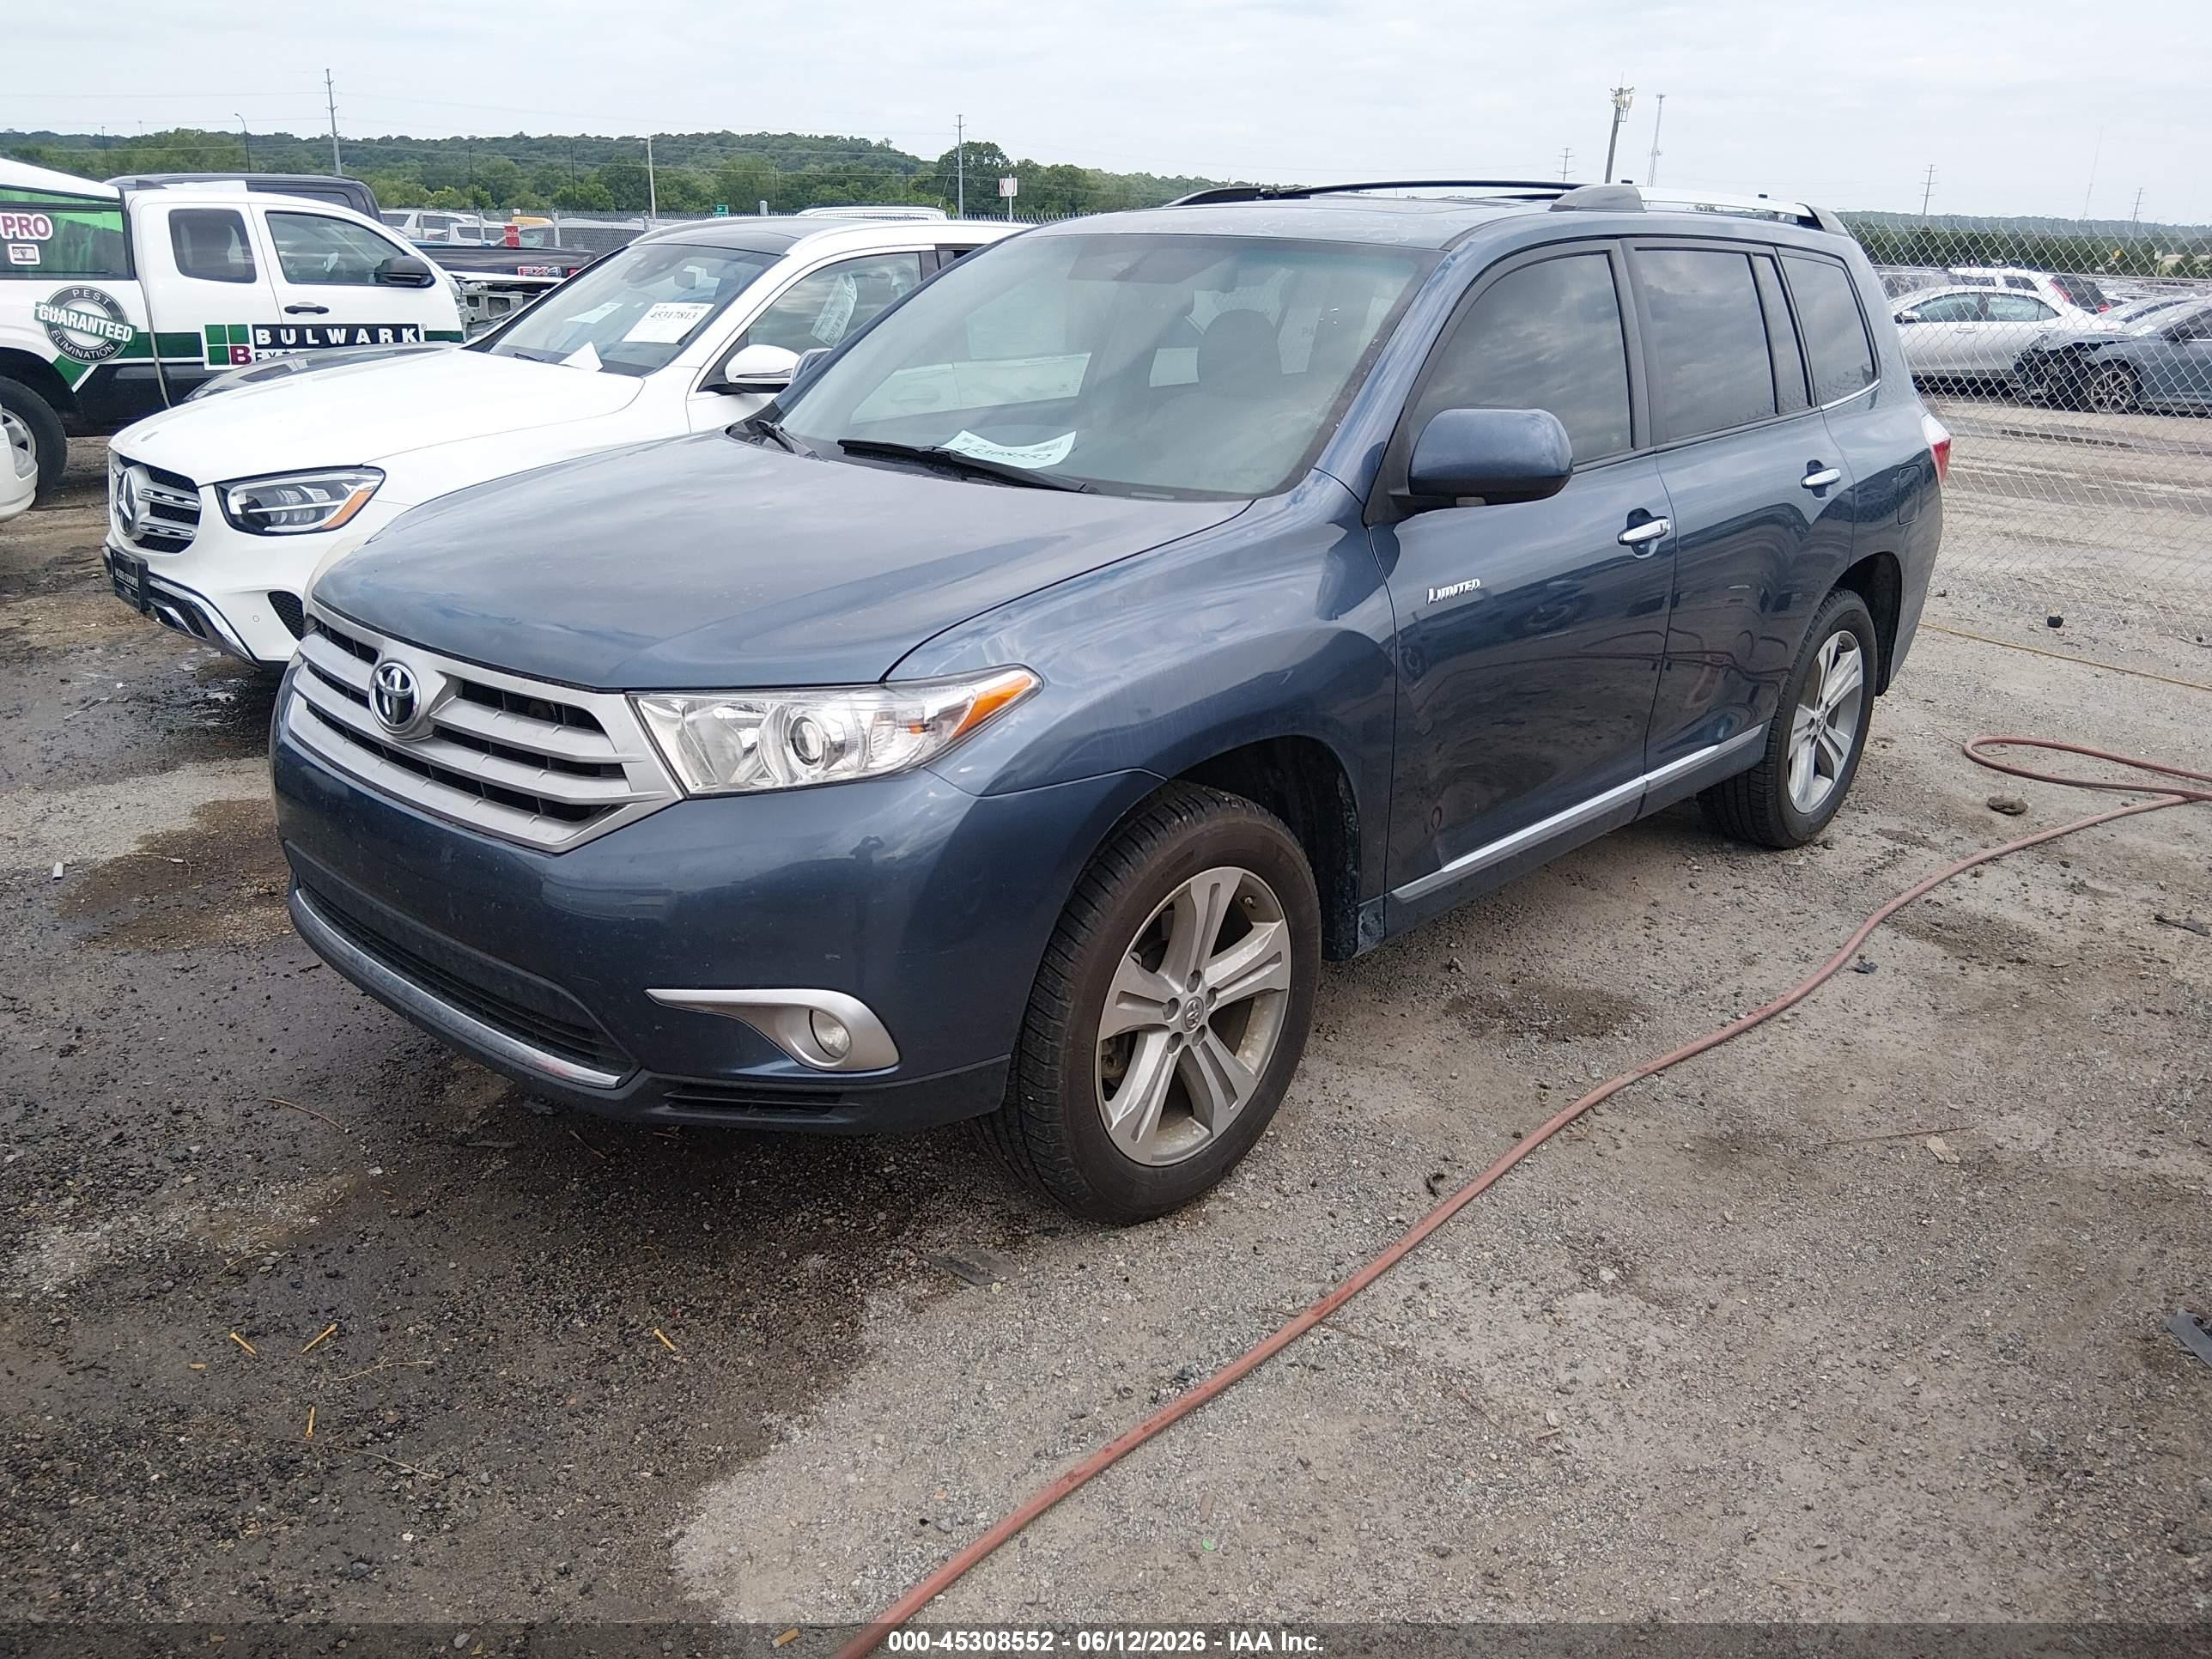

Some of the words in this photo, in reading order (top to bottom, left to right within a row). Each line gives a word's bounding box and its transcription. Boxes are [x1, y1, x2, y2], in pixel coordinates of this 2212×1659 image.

[1, 215, 52, 238] PRO
[517, 266, 562, 277] FX4
[71, 289, 112, 306] PEST
[37, 303, 133, 343] GUARANTEED
[51, 329, 115, 360] ELIMINATION
[255, 328, 419, 345] BULWARK
[229, 345, 252, 366] B
[1426, 578, 1481, 605] LIMITED
